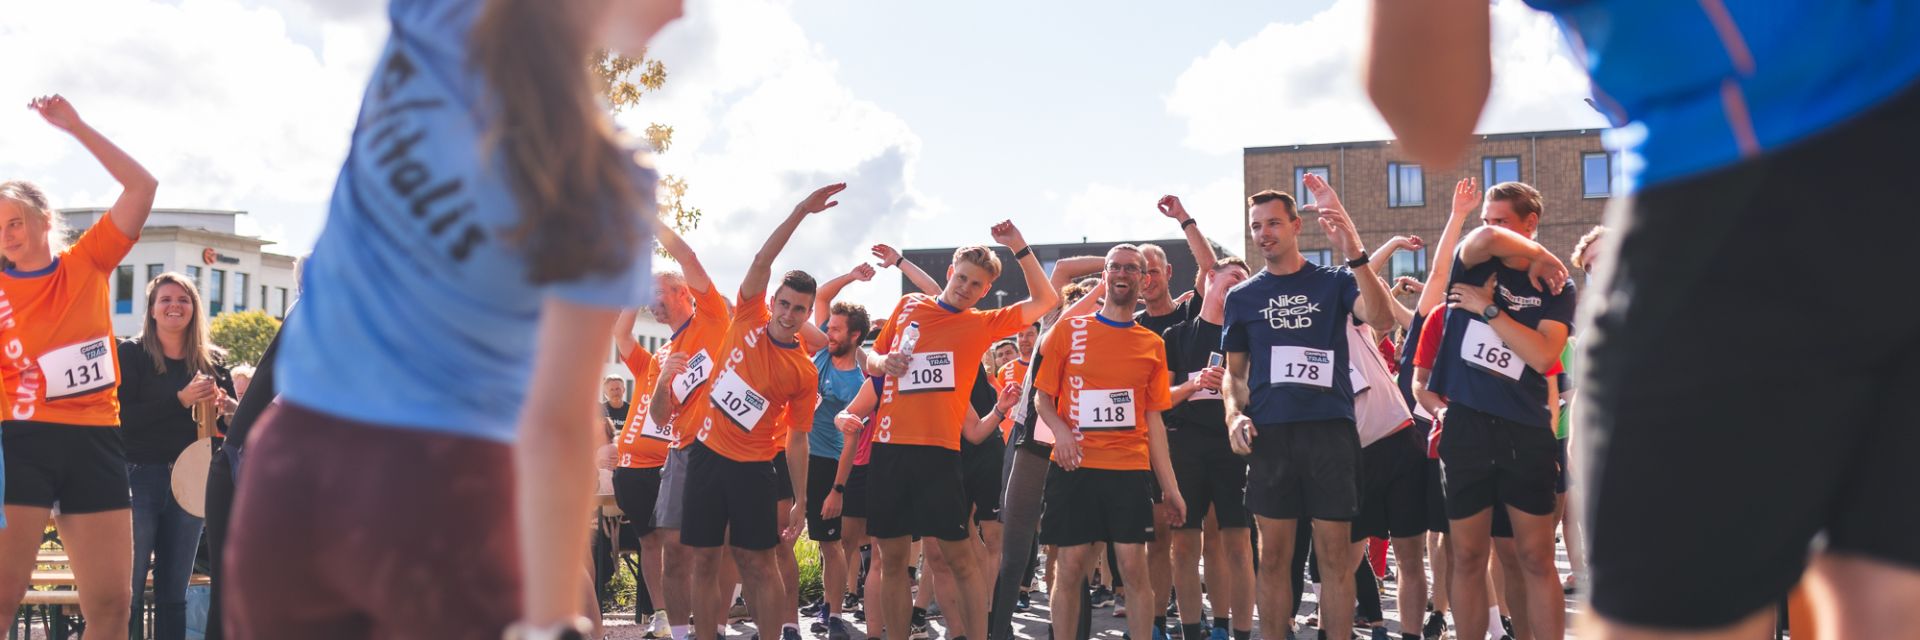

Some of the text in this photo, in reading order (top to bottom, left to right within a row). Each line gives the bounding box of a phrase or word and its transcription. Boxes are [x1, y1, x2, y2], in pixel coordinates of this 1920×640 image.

[1269, 294, 1308, 309] Nike
[1259, 302, 1321, 319] Track
[1269, 315, 1312, 330] Club
[1473, 343, 1511, 369] 168
[65, 362, 103, 388] 131
[682, 366, 704, 390] 127
[912, 368, 943, 385] 108
[1284, 363, 1319, 380] 178
[722, 391, 751, 416] 107
[1093, 407, 1125, 422] 118
